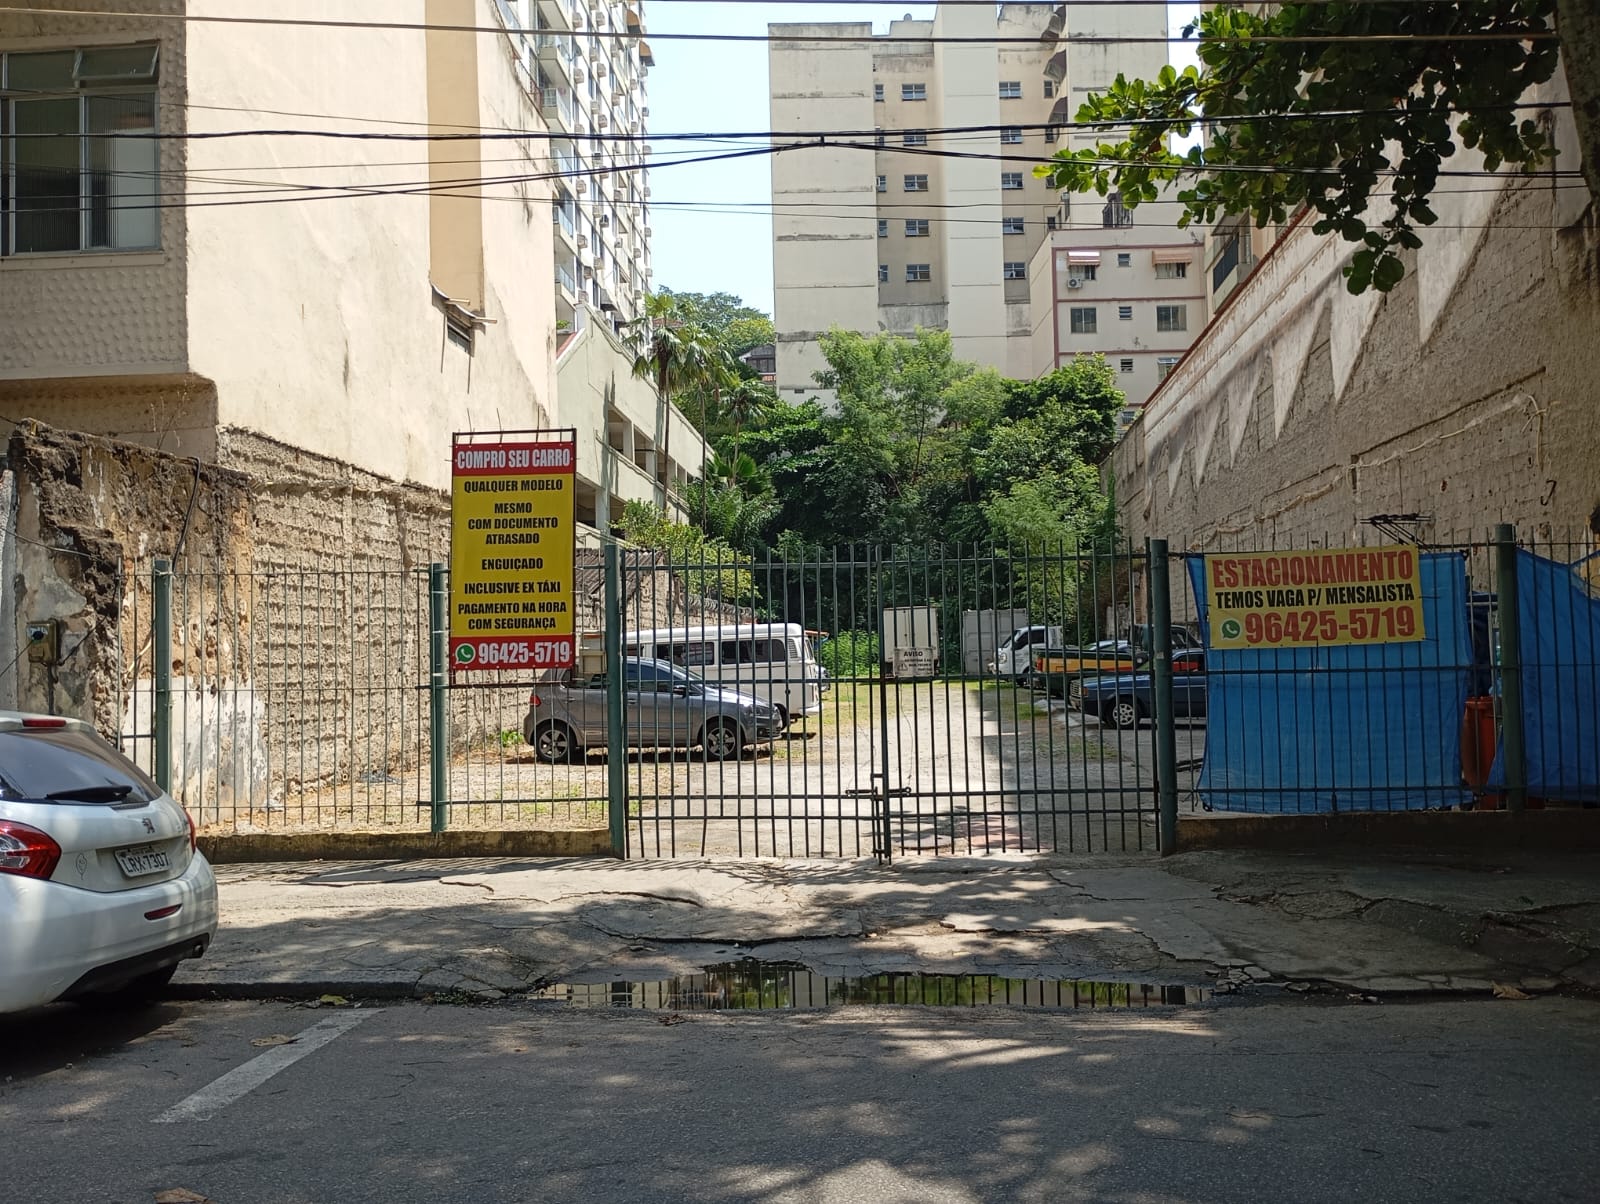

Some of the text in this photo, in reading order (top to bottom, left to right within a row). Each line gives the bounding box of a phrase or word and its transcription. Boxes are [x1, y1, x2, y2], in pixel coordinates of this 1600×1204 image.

[457, 449, 571, 469] COMPRO SEU CARRO
[464, 479, 563, 493] QUALQUER MODELO
[494, 502, 533, 514] MESMO
[468, 517, 558, 530] COM DOCUMENTO
[485, 533, 540, 545] ATRASADO
[481, 558, 544, 572] ENGUIÇADO
[1212, 550, 1413, 588] ESTACIONAMENTO
[464, 579, 561, 594] INCLUSIVE EX TÁXI
[1215, 583, 1414, 609] TEMOS VAGA P/ MENSALISTA
[458, 601, 567, 615] PAGAMENTO NA HORA
[468, 617, 556, 631] COM SEGURANÇA
[1244, 605, 1416, 644] 96425-5719
[478, 641, 570, 665] 96425-5719
